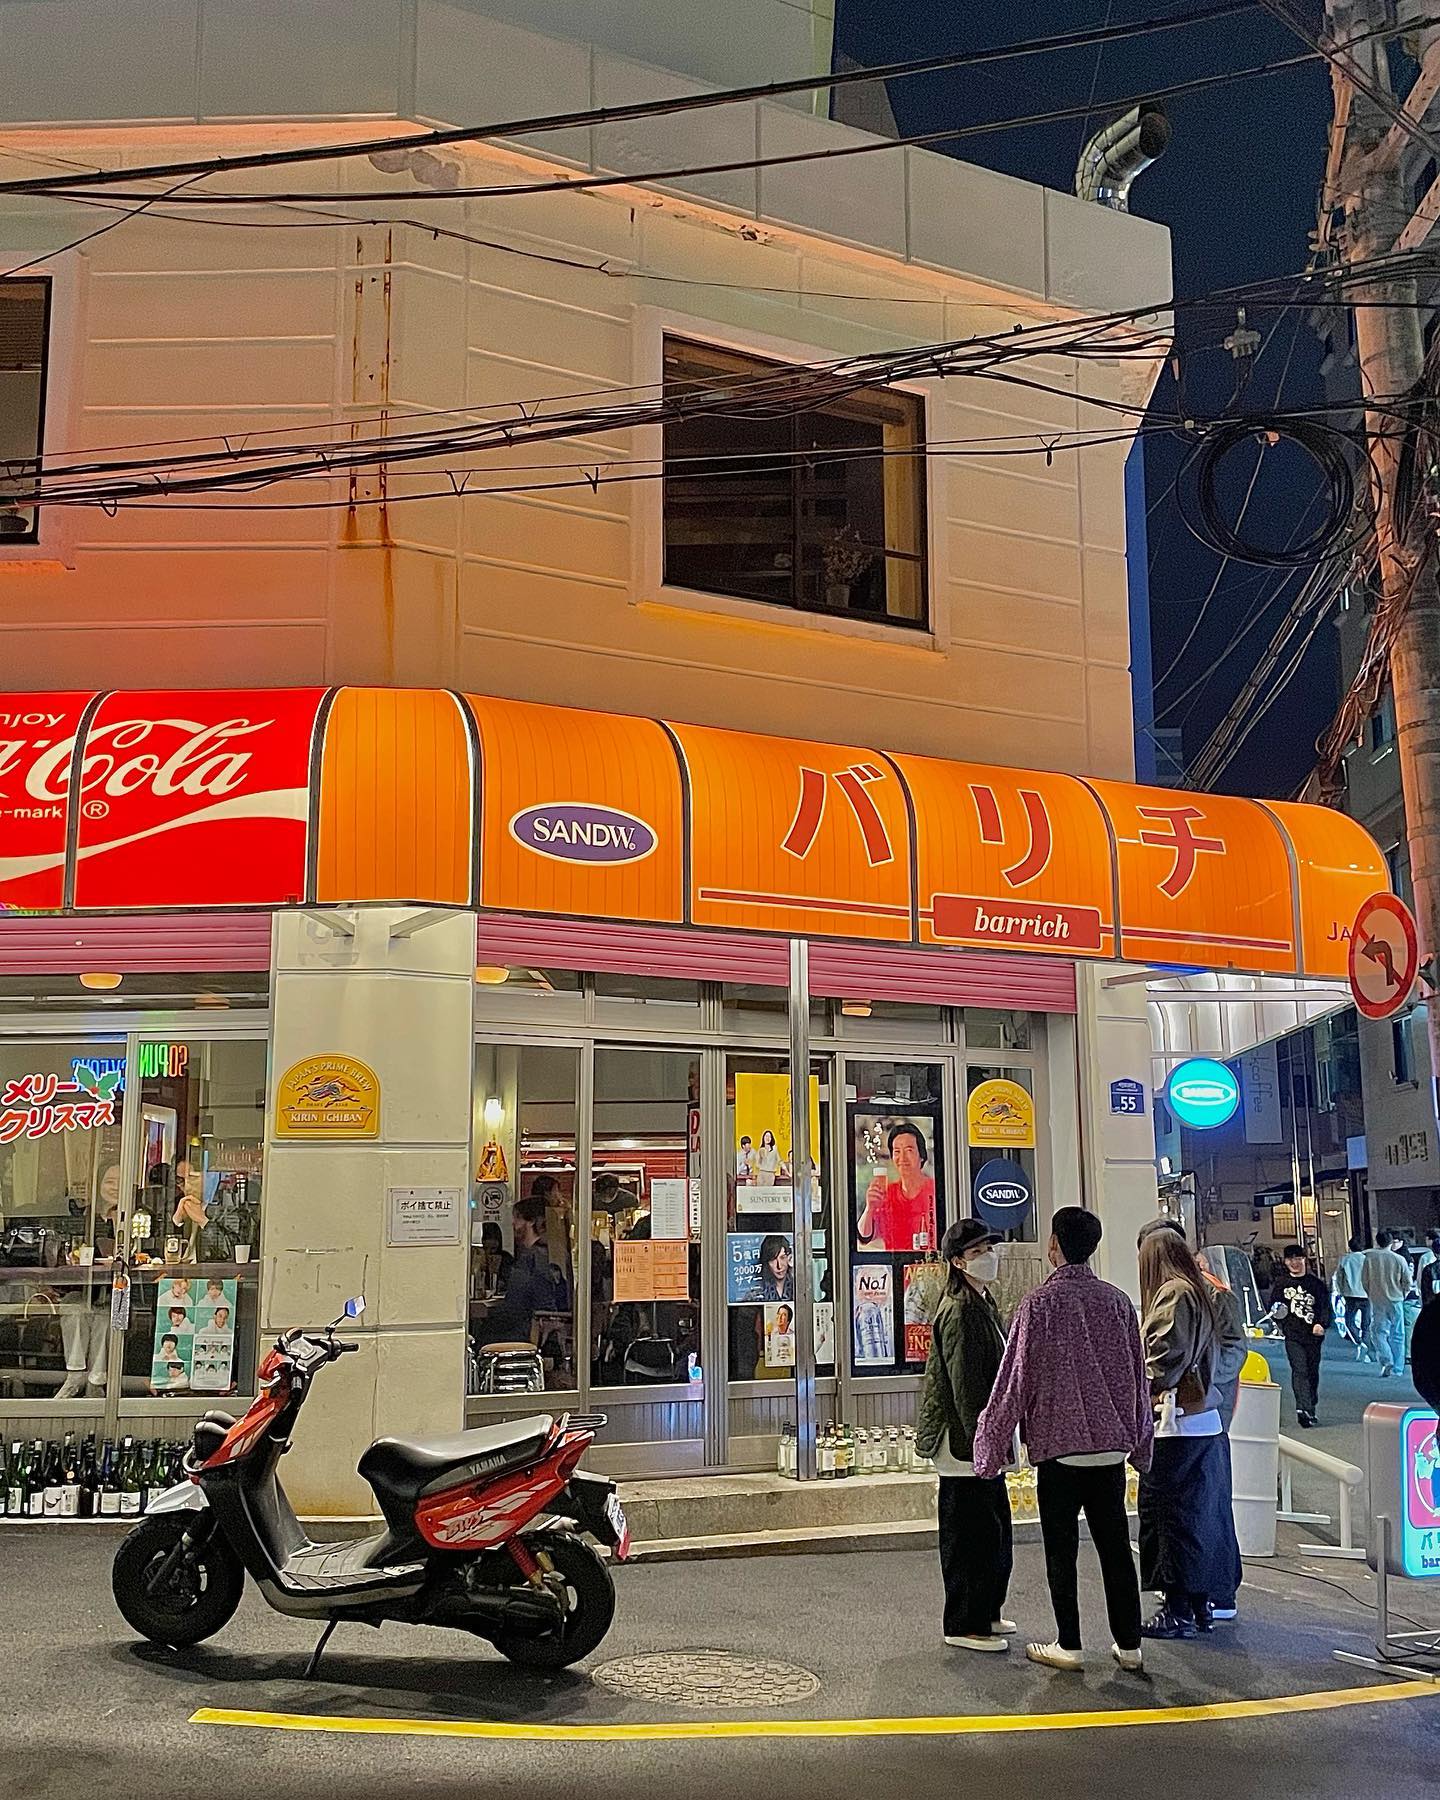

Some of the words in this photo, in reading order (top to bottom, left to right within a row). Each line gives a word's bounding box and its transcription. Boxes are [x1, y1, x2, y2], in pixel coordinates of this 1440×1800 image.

[0, 806, 63, 819] -mark
[974, 906, 1070, 940] barrich
[319, 1062, 350, 1073] PRIME
[1, 1073, 79, 1106] メリー
[1120, 1096, 1136, 1111] 55
[0, 1101, 115, 1144] クリスマス
[291, 1113, 318, 1122] KIRIN
[323, 1113, 363, 1122] ICHIBAN
[859, 1273, 888, 1291] No.1
[469, 1454, 507, 1475] YAMAHA
